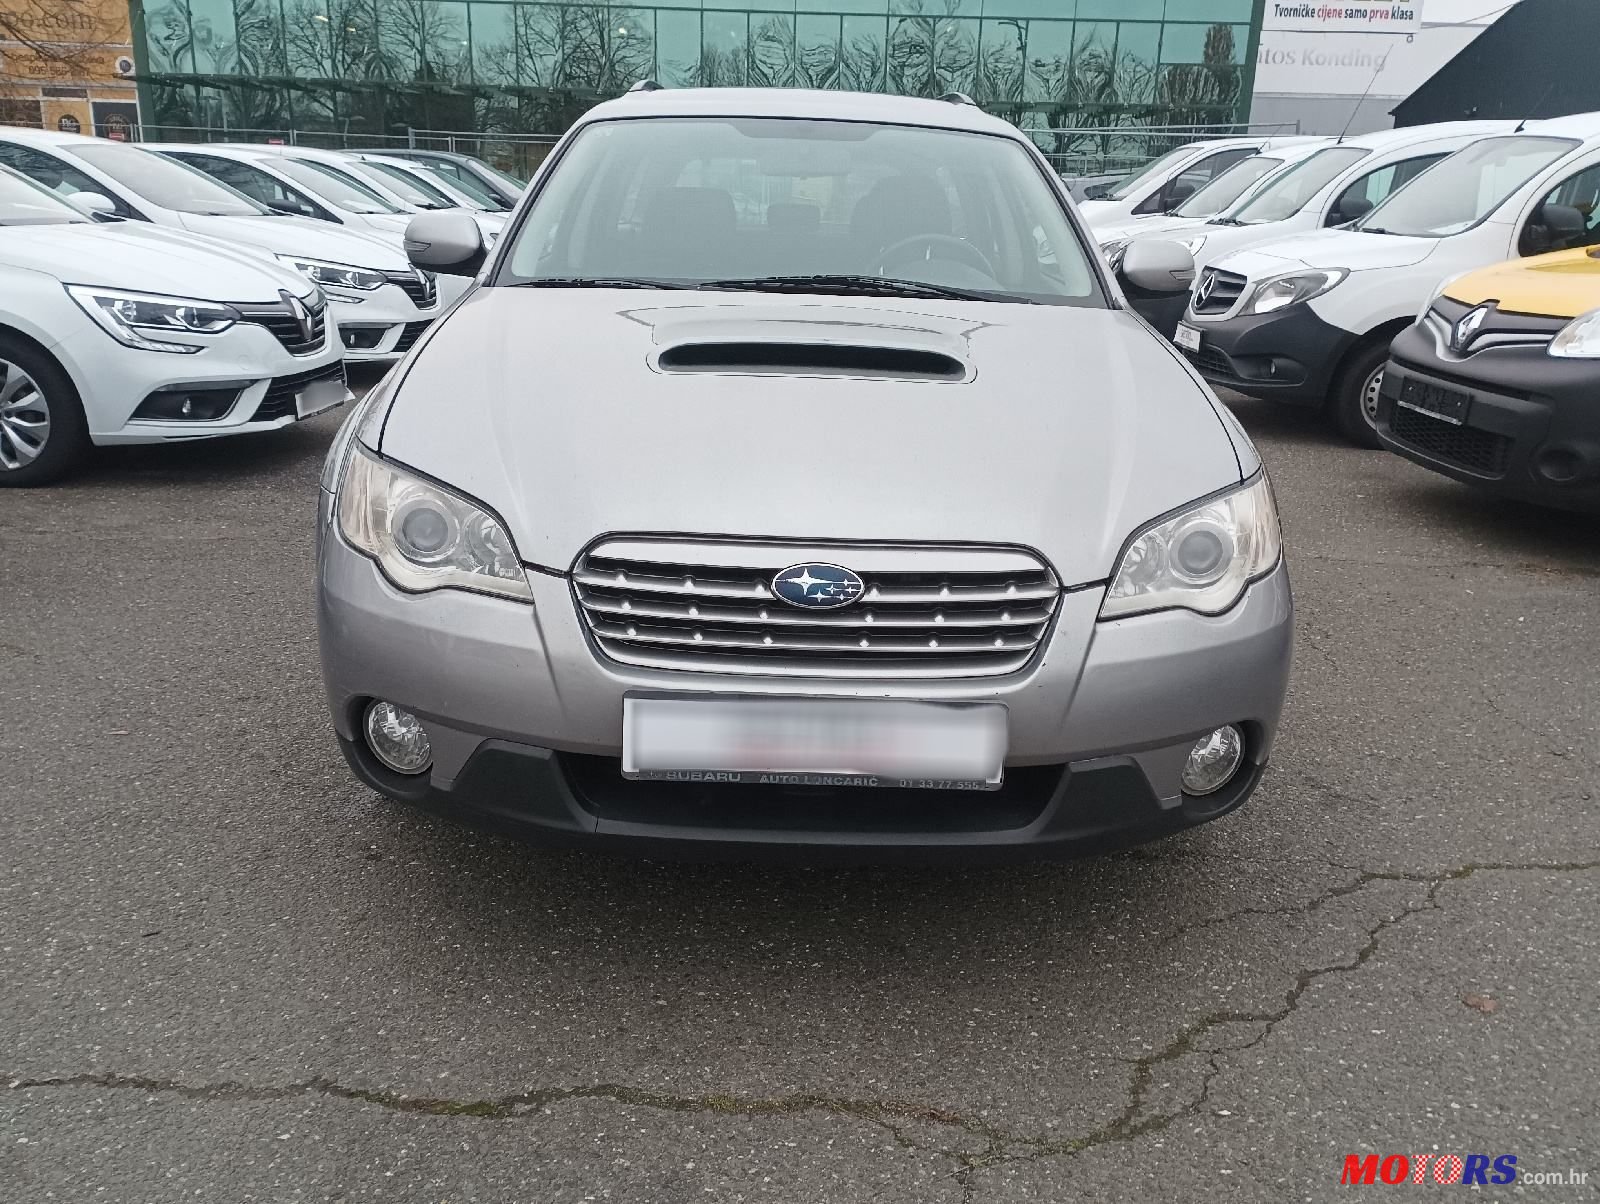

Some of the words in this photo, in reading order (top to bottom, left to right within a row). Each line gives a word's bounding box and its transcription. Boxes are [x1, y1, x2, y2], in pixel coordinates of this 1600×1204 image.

[1274, 4, 1316, 18] Tvorničke
[1317, 5, 1343, 21] cijene
[1344, 8, 1368, 19] samo
[1369, 9, 1389, 22] prva
[1391, 5, 1414, 20] klasa
[667, 771, 741, 782] SUBARU
[760, 774, 799, 784] AUTO
[919, 780, 934, 788] 33
[938, 781, 952, 789] 77
